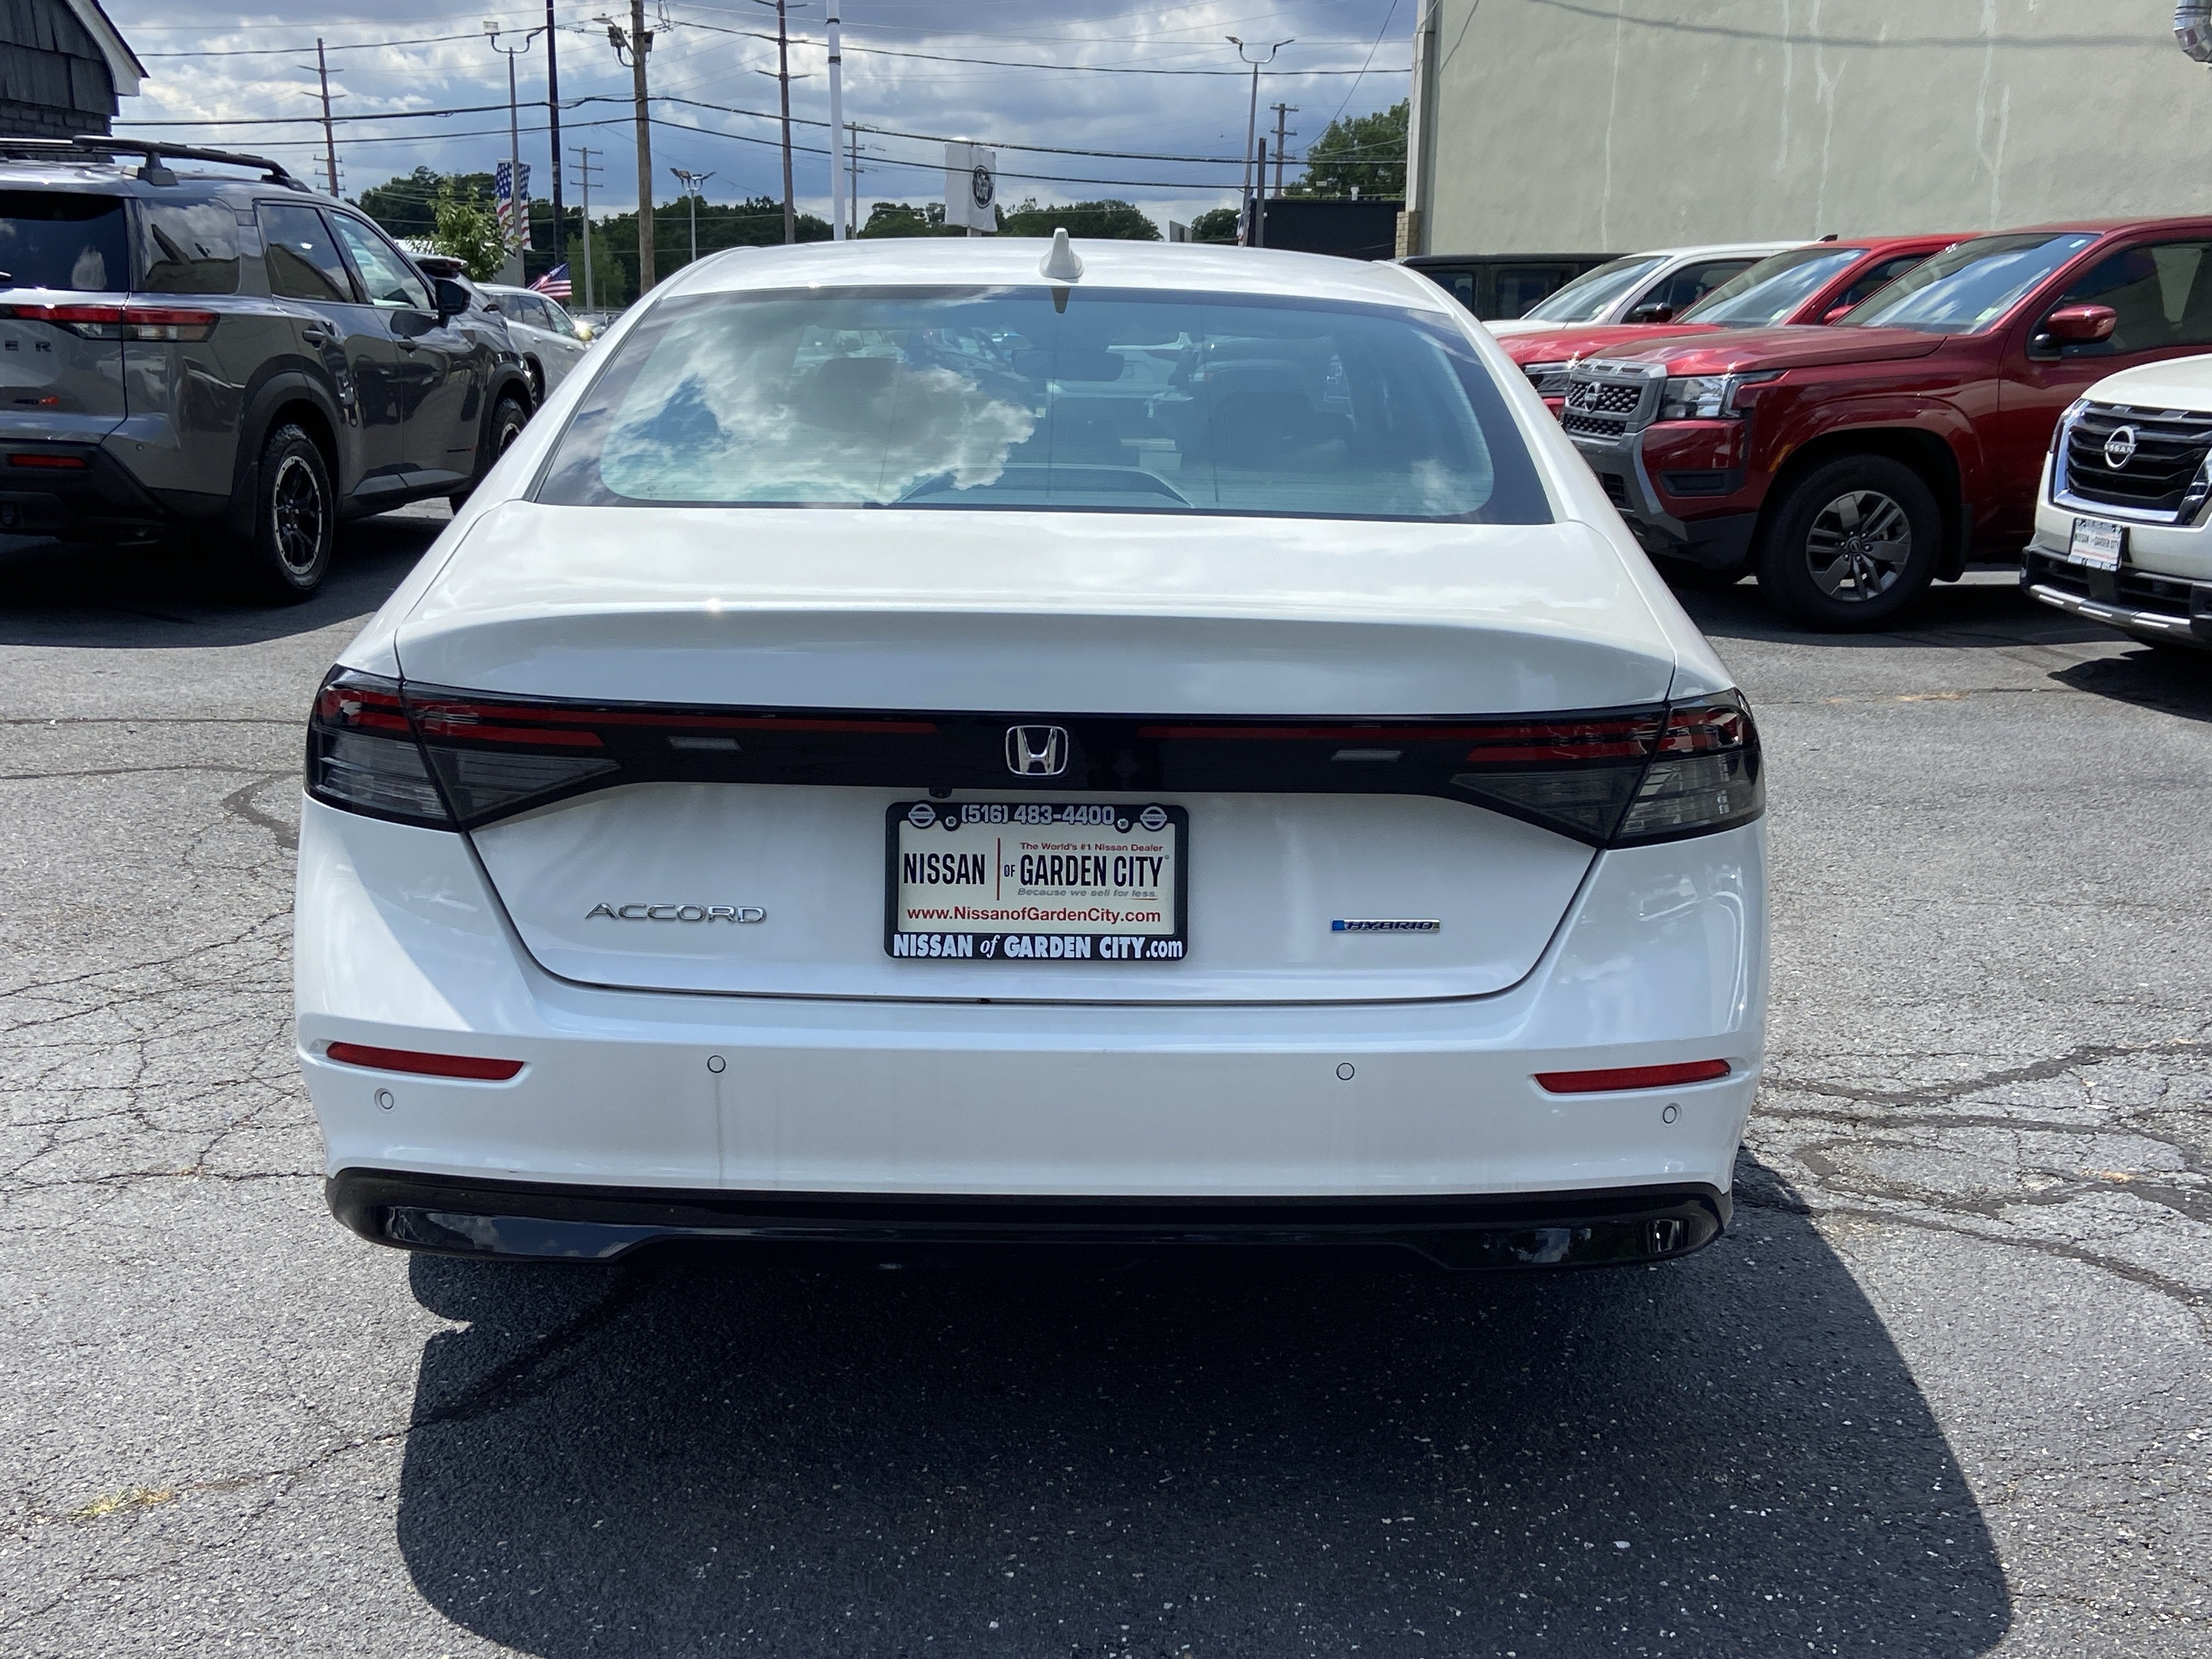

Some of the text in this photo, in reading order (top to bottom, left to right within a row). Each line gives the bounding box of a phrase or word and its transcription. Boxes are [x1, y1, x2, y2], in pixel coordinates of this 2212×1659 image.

[961, 804, 1115, 825] (516) 483-4400
[1041, 843, 1077, 851] World's
[904, 853, 985, 885] NISSAN
[1003, 864, 1015, 877] OF
[1020, 854, 1107, 887] GARDEN
[1017, 888, 1066, 896] Because
[584, 902, 767, 923] ACCORD
[907, 906, 1161, 924] www.NissanofGardenCity.com
[1346, 921, 1434, 930] HYBRID
[893, 934, 1183, 958] NISSAN of GARDEN CITY.com
